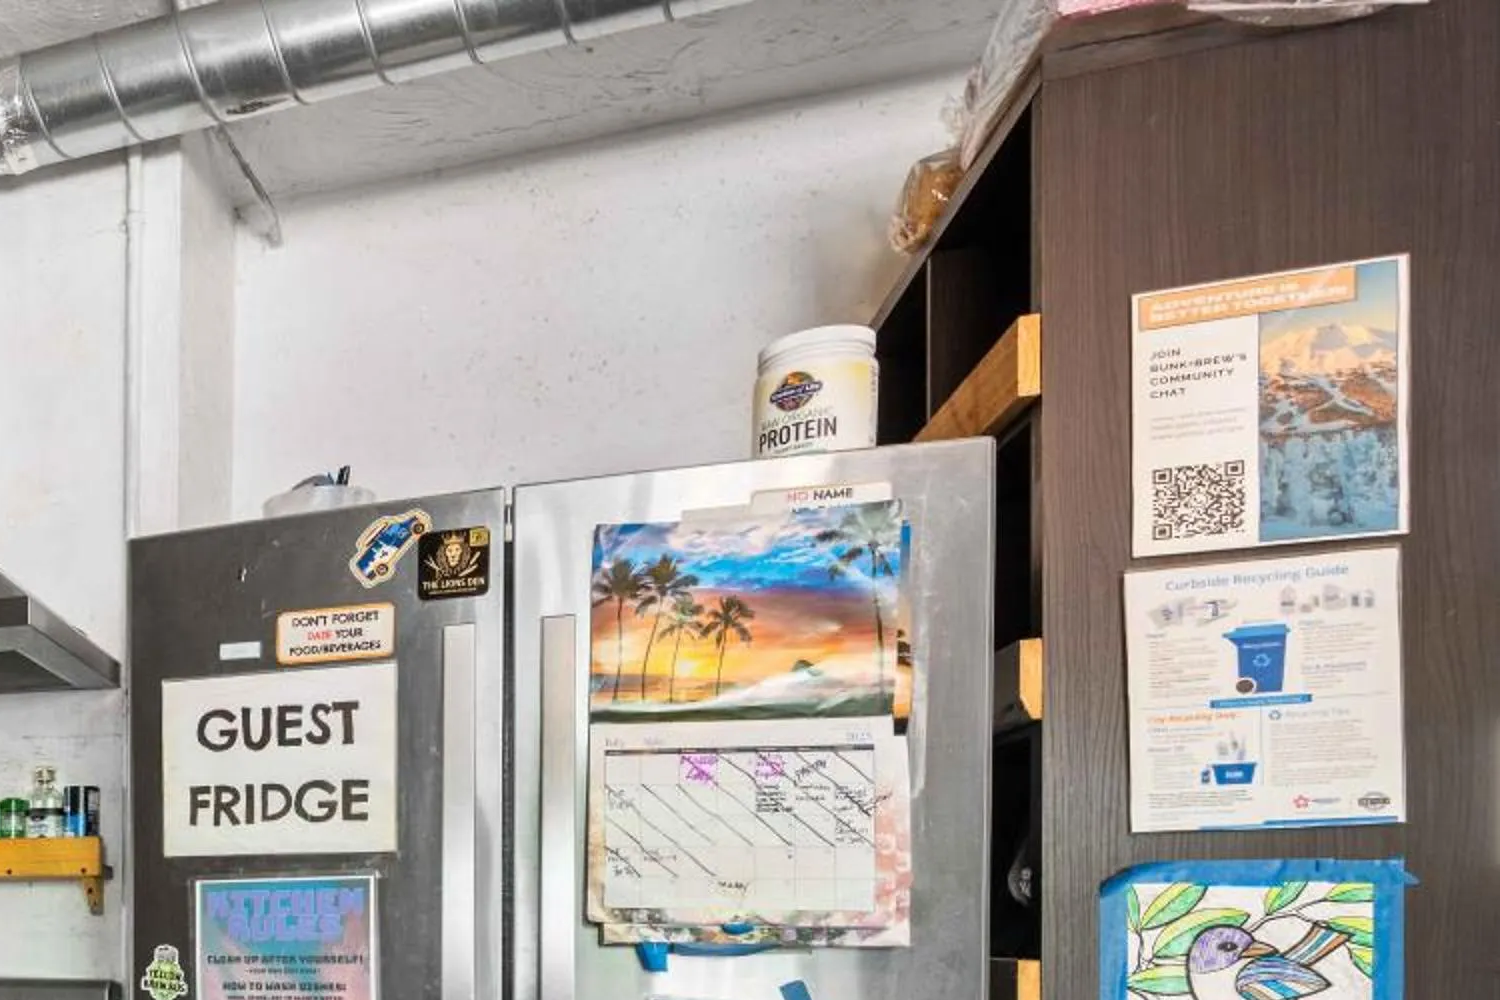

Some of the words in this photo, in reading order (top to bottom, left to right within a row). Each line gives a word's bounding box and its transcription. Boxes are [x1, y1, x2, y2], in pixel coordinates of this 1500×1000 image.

[1150, 347, 1181, 360] JOIN
[1149, 368, 1234, 387] COMMUNITY
[1149, 387, 1186, 399] CHAT
[759, 415, 837, 454] PROTEIN
[813, 488, 853, 501] NAME
[291, 615, 329, 628] DON'T
[331, 610, 379, 625] FORGET
[335, 628, 363, 639] YOUR
[289, 640, 381, 657] FOOD/BEVERAGES
[197, 701, 359, 752] GUEST
[189, 779, 370, 827] FRIDGE
[205, 887, 365, 920] KITCHEN
[227, 914, 345, 944] RULES
[207, 955, 242, 965] CLEAN
[243, 955, 259, 965] UP
[260, 955, 298, 965] AFTER
[222, 981, 246, 991] HOW
[250, 981, 262, 991] TO
[265, 981, 297, 991] WASH
